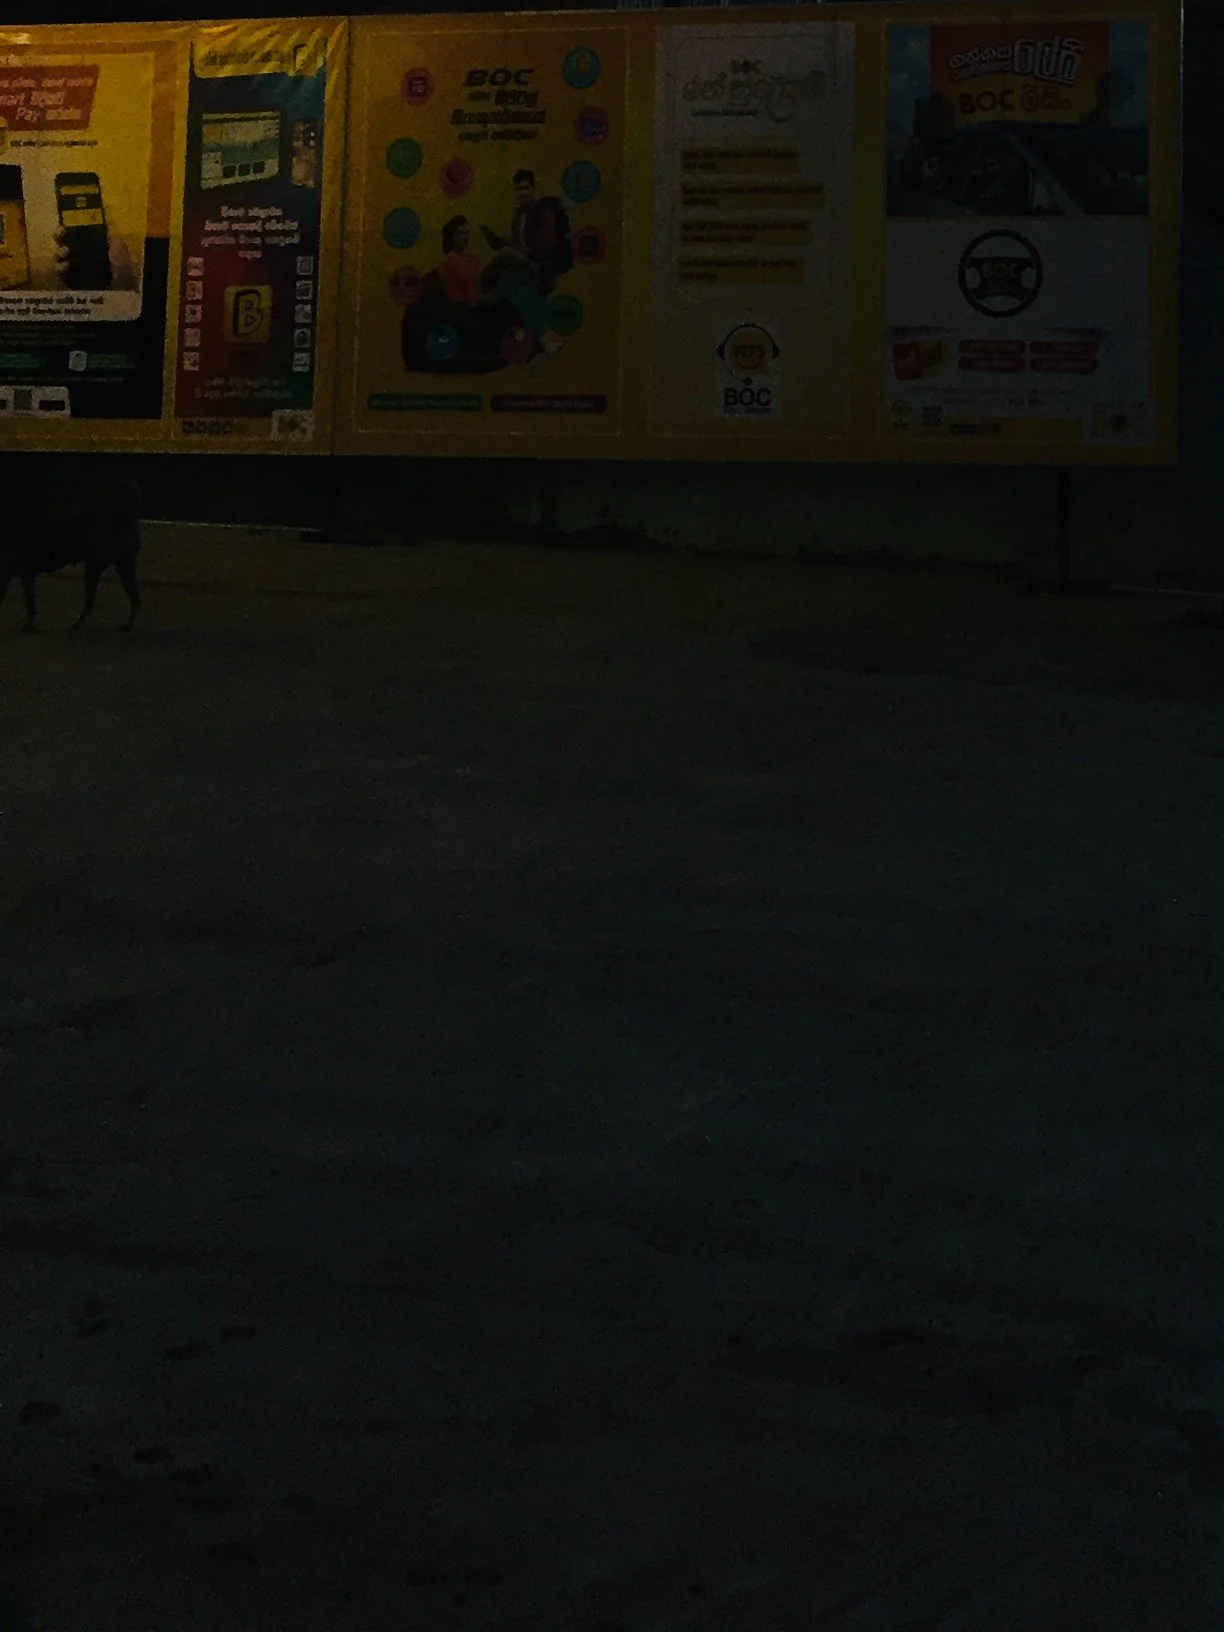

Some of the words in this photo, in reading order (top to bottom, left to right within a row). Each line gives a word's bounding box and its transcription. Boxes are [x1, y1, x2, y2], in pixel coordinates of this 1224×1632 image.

[464, 69, 535, 87] BOC
[958, 88, 1015, 115] BOC
[723, 386, 772, 407] BOC
